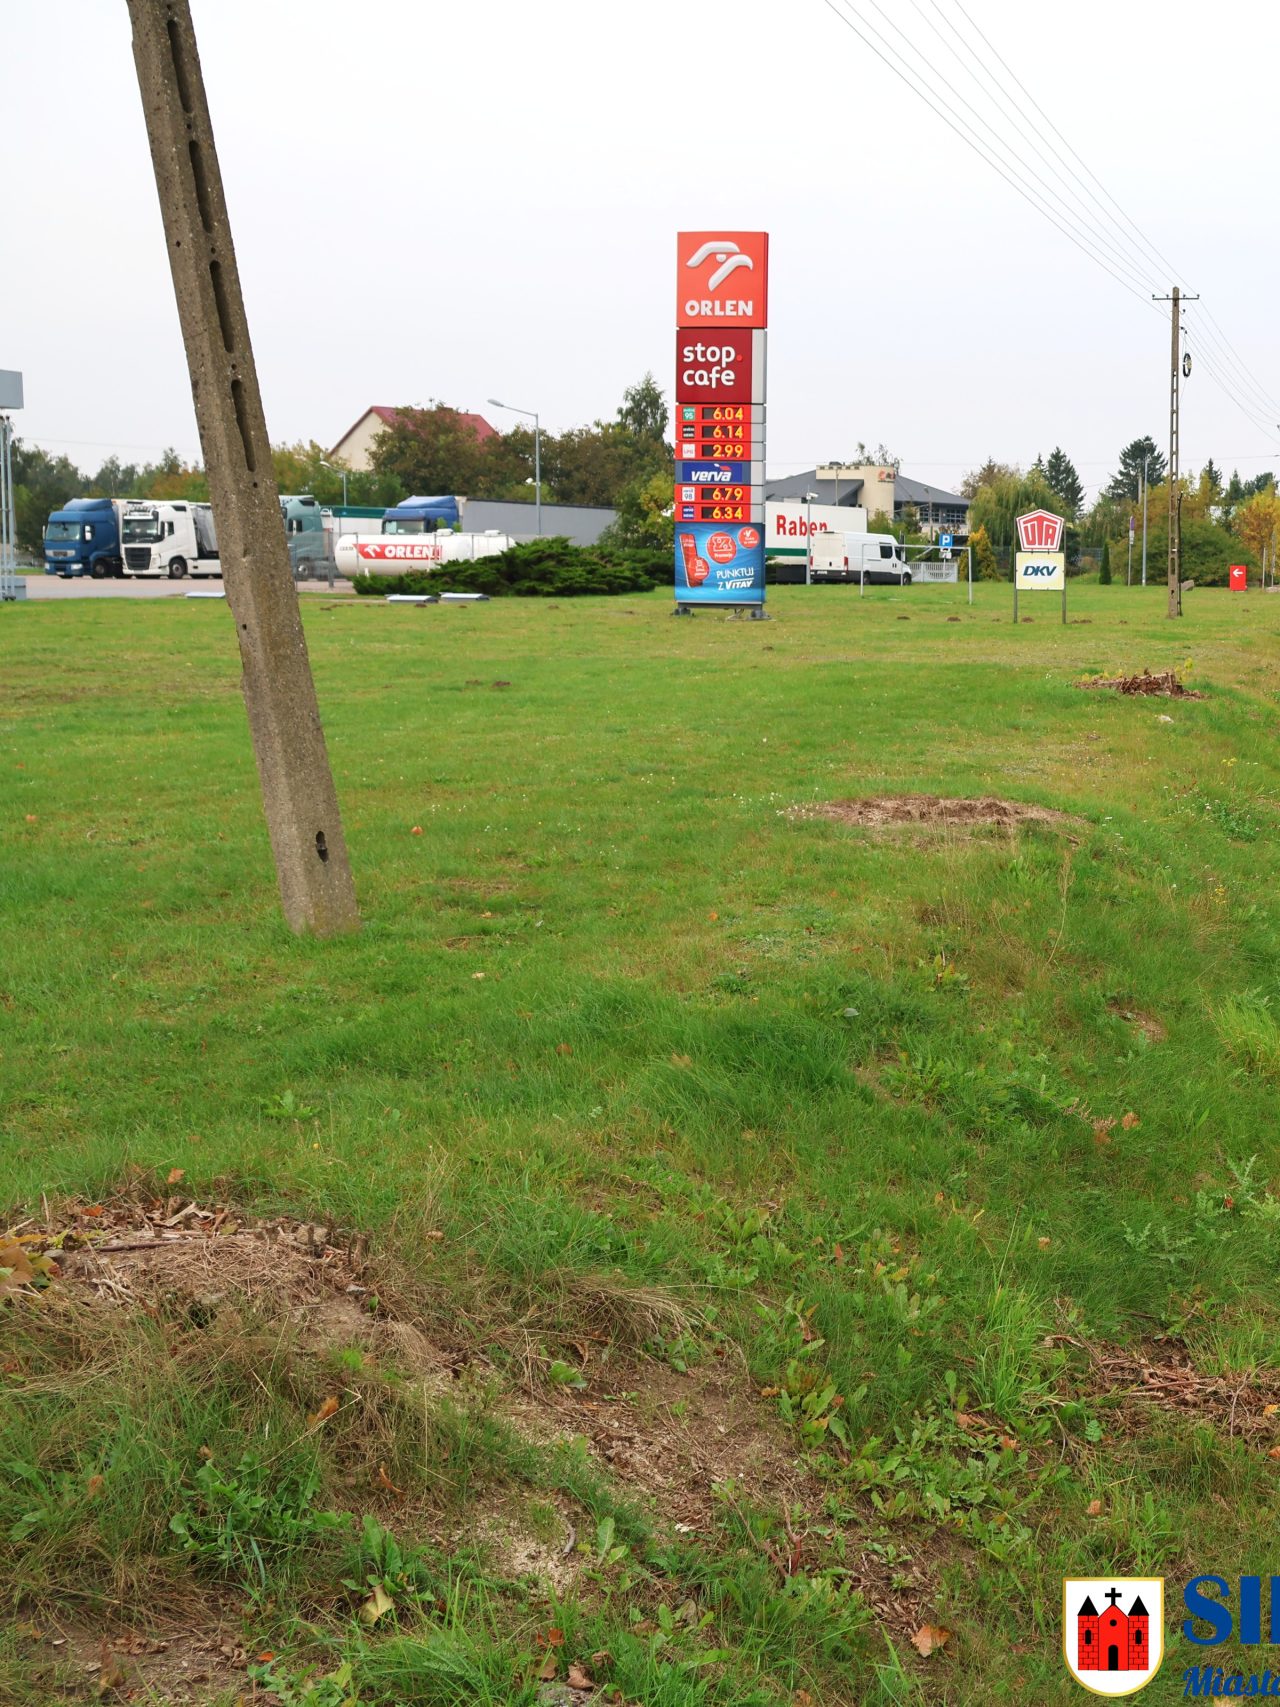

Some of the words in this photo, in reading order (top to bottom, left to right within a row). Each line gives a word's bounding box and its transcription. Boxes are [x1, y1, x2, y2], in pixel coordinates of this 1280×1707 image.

[685, 300, 753, 316] ORLEN
[683, 366, 735, 388] cafe
[713, 407, 743, 420] 6.04
[713, 425, 743, 438] 6.14
[713, 444, 743, 457] 2.99
[691, 471, 731, 482] verva
[713, 488, 743, 500] 6.79
[713, 507, 743, 519] 6.34
[776, 515, 828, 536] Raben
[1023, 515, 1058, 546] UTA
[942, 535, 950, 546] P
[384, 545, 434, 558] ORLEN
[716, 567, 755, 580] PUNKTUJ
[1023, 566, 1057, 576] DKV
